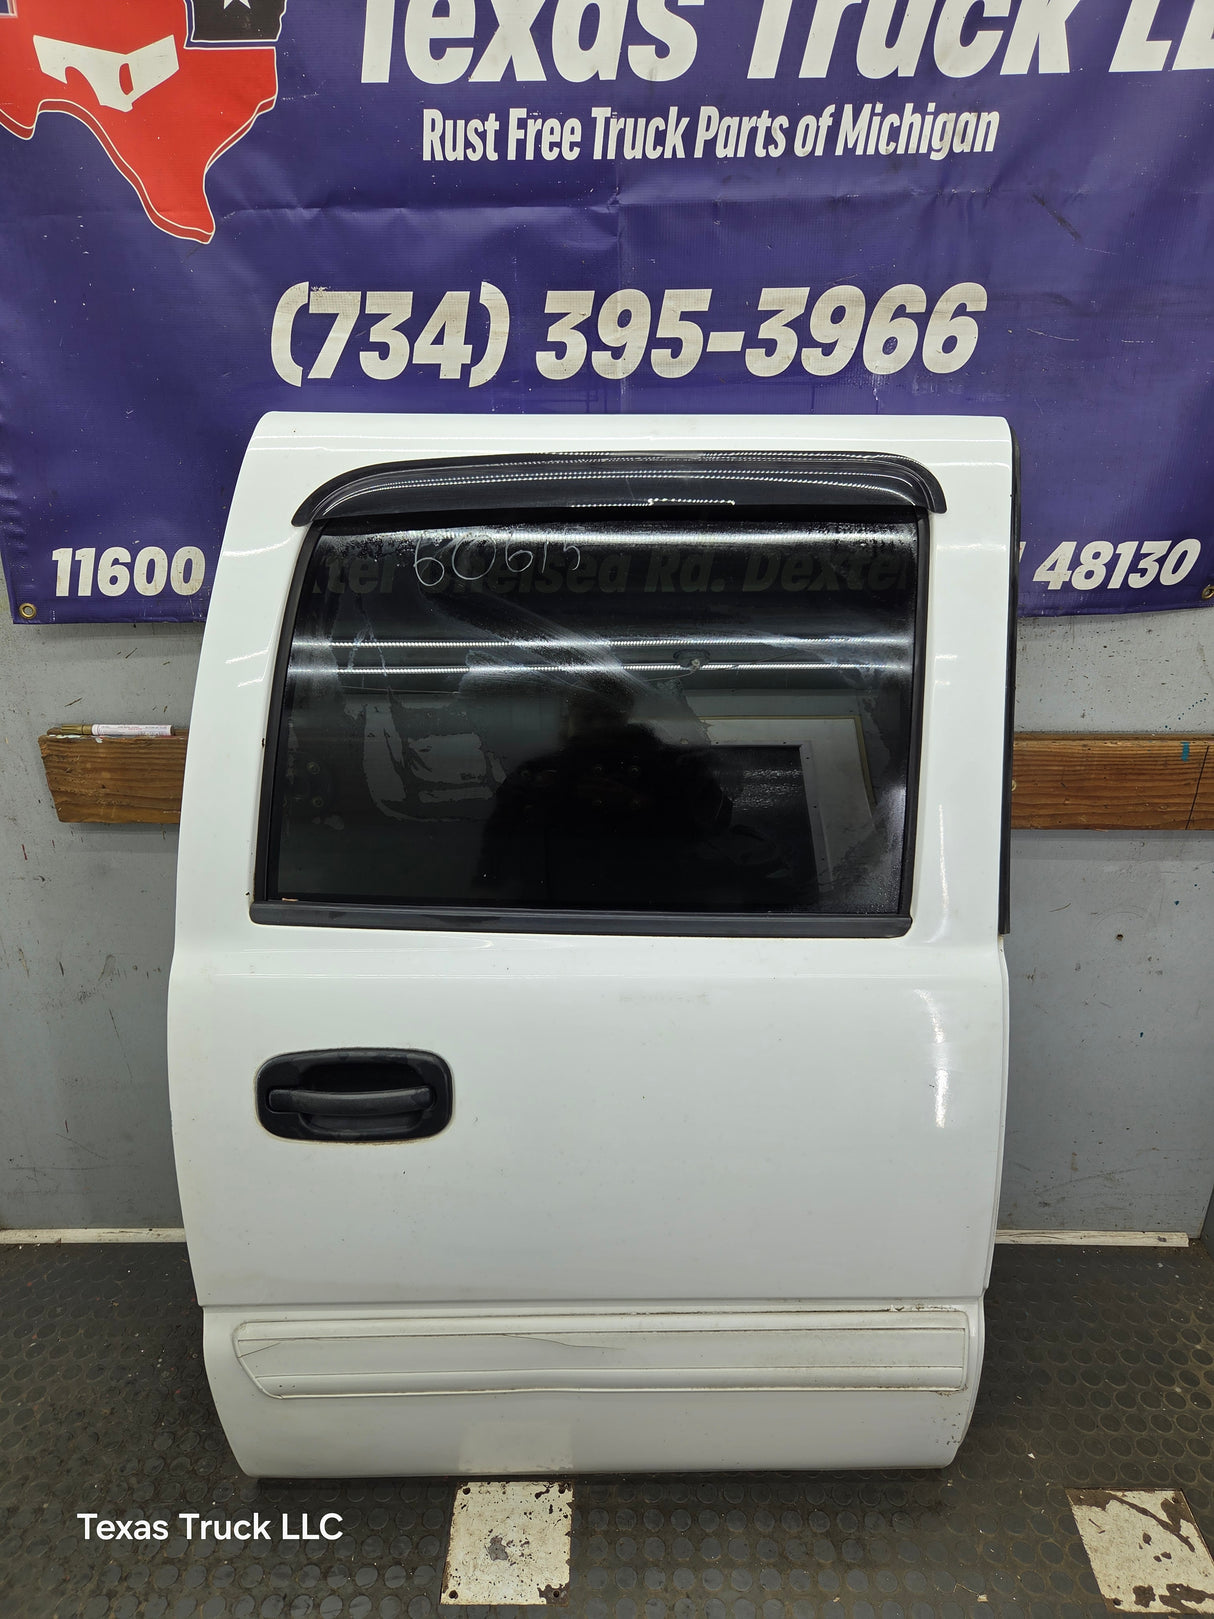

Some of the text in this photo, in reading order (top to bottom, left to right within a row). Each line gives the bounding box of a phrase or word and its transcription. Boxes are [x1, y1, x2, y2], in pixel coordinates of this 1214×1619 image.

[422, 102, 1000, 161] Rust Free Truck Parts of Michigan
[270, 281, 988, 388] (734) 395-3966
[52, 546, 206, 597] 11600
[643, 547, 727, 593] Rd.
[1032, 538, 1202, 591] 48130
